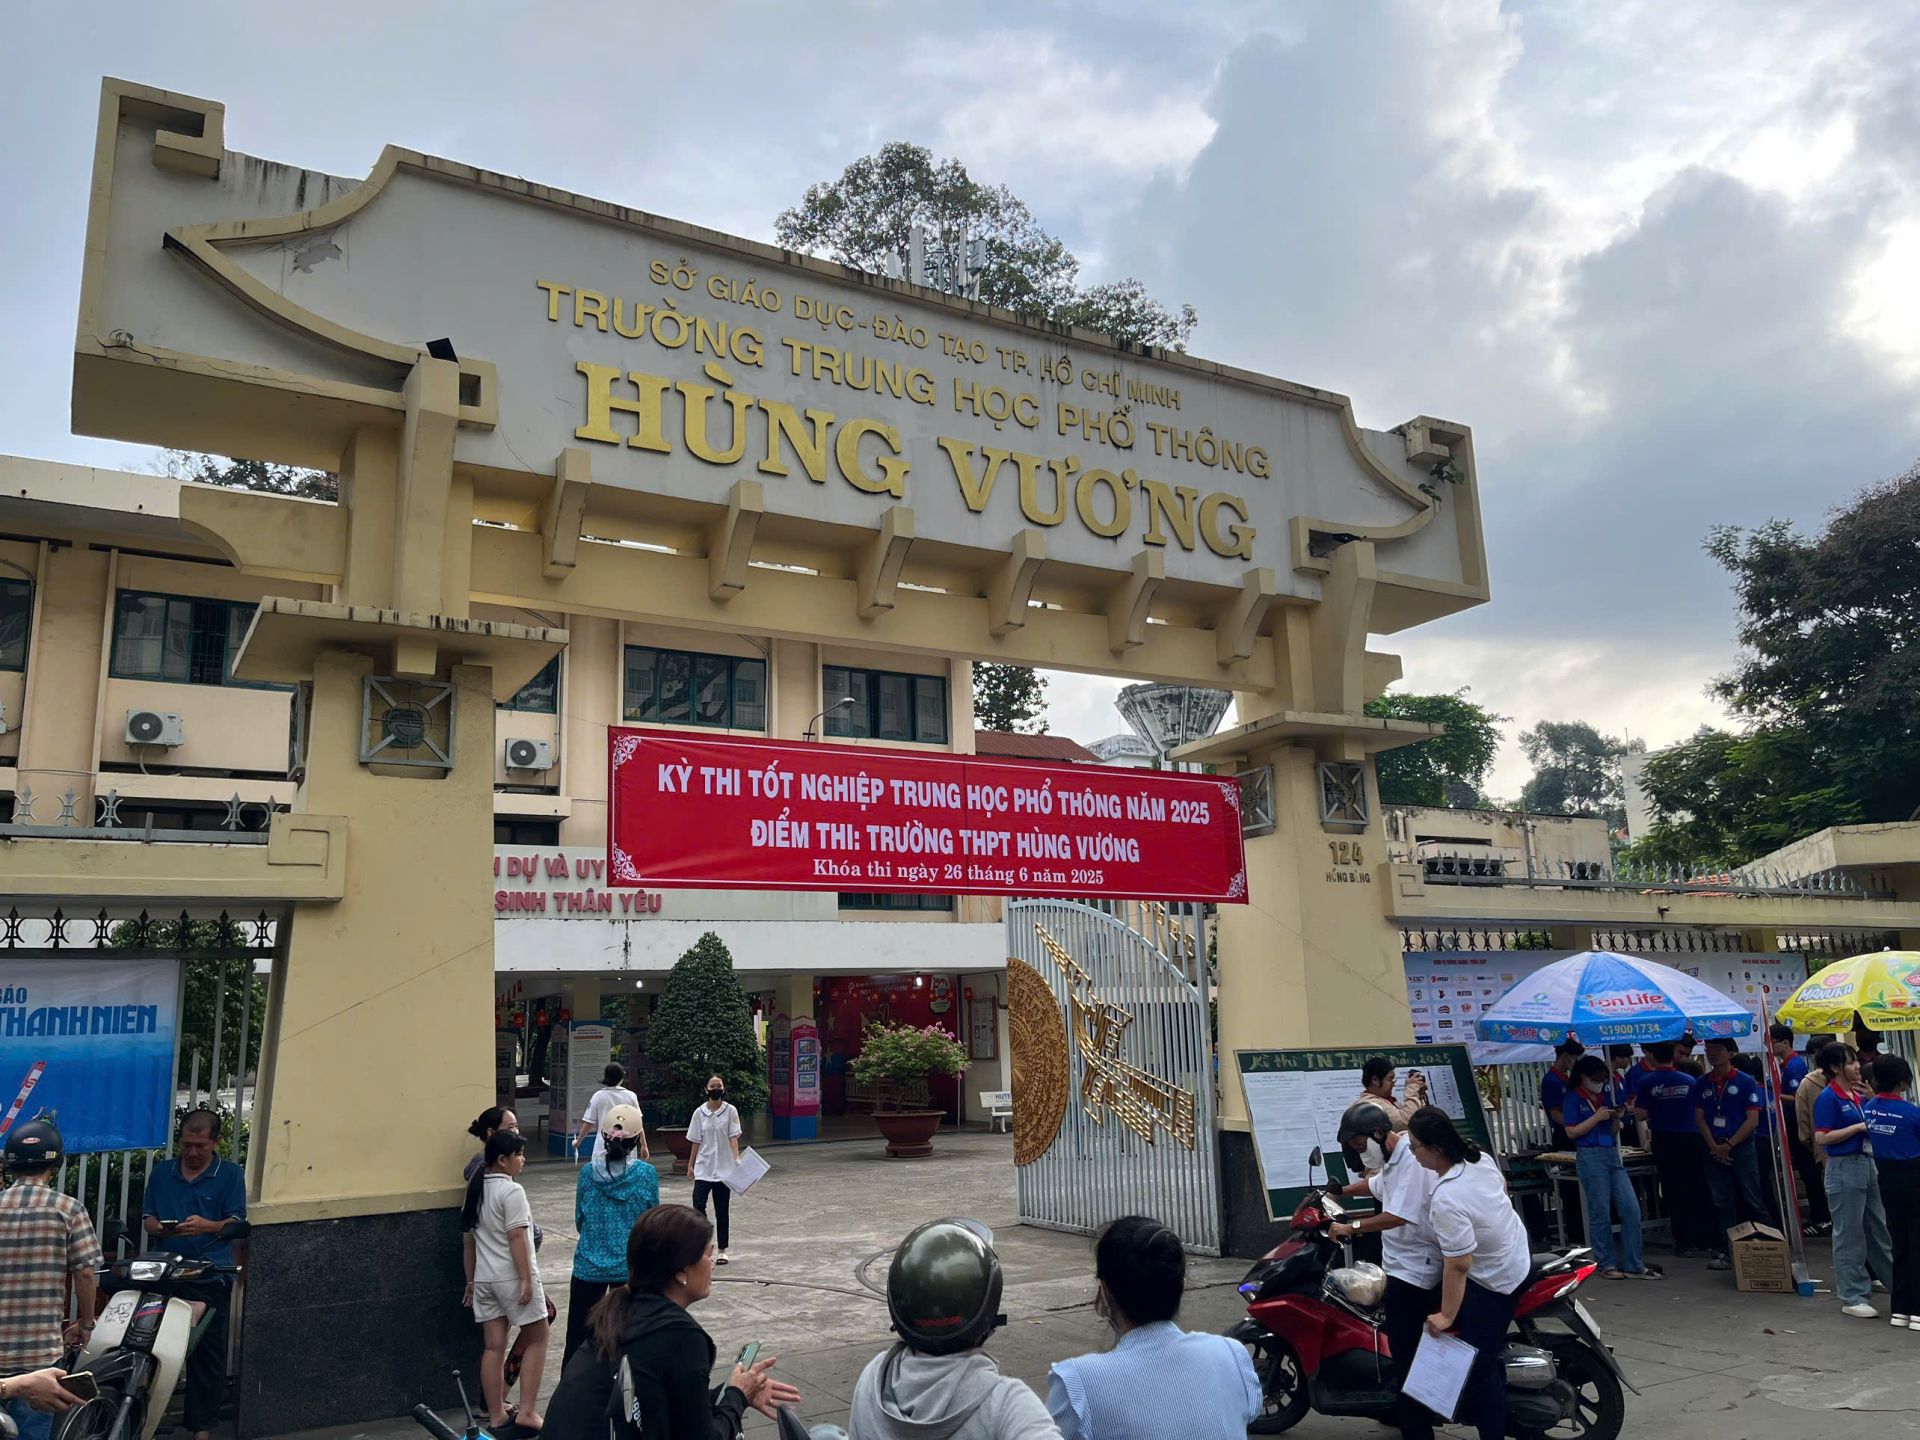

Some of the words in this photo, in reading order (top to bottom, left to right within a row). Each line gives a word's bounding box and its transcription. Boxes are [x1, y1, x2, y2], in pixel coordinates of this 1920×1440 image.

[649, 257, 698, 291] SỞ
[706, 278, 783, 313] GIÁO
[938, 331, 990, 364] TẠO
[996, 346, 1033, 377] TP.
[1081, 367, 1121, 398] CHÍ
[1127, 377, 1182, 411] MINH
[536, 279, 765, 367] TRƯỜNG
[782, 337, 936, 407] TRUNG
[954, 377, 1041, 431] HỌC
[1057, 402, 1136, 450] PHỔ
[1147, 425, 1270, 479] THÔNG
[574, 360, 912, 499] HÙNG
[937, 436, 1257, 562] VƯƠNG
[658, 757, 693, 794] KỲ
[700, 766, 741, 796] THI
[748, 759, 794, 799] TỐT
[801, 771, 885, 812] NGHIỆP
[889, 779, 961, 809] TRUNG
[967, 784, 1009, 819] HỌC
[1013, 777, 1053, 815] PHỔ
[1057, 787, 1122, 819] THÔNG
[1126, 791, 1167, 822] NĂM
[1170, 799, 1211, 826] 2025
[750, 806, 810, 849] ĐIỂM
[815, 822, 861, 851] THI:
[866, 819, 954, 855] TRƯỜNG
[958, 829, 1011, 857] THPT
[1016, 826, 1071, 860] HÙNG
[1075, 832, 1140, 863] VƯƠNG
[1328, 840, 1364, 866] 124
[507, 853, 540, 884] DỰ
[543, 852, 570, 879] VÀ
[575, 859, 606, 879] UY
[812, 858, 862, 878] Khóa
[867, 860, 892, 879] thi
[897, 862, 939, 883] ngày
[944, 864, 963, 880] 26
[967, 864, 1014, 886] tháng
[1018, 866, 1028, 882] 6
[1032, 869, 1067, 884] năm
[1071, 869, 1104, 885] 2025
[494, 890, 547, 912] SINH
[553, 887, 612, 914] THÂN
[618, 888, 662, 914] YÊU
[1419, 1052, 1452, 1065] 2025
